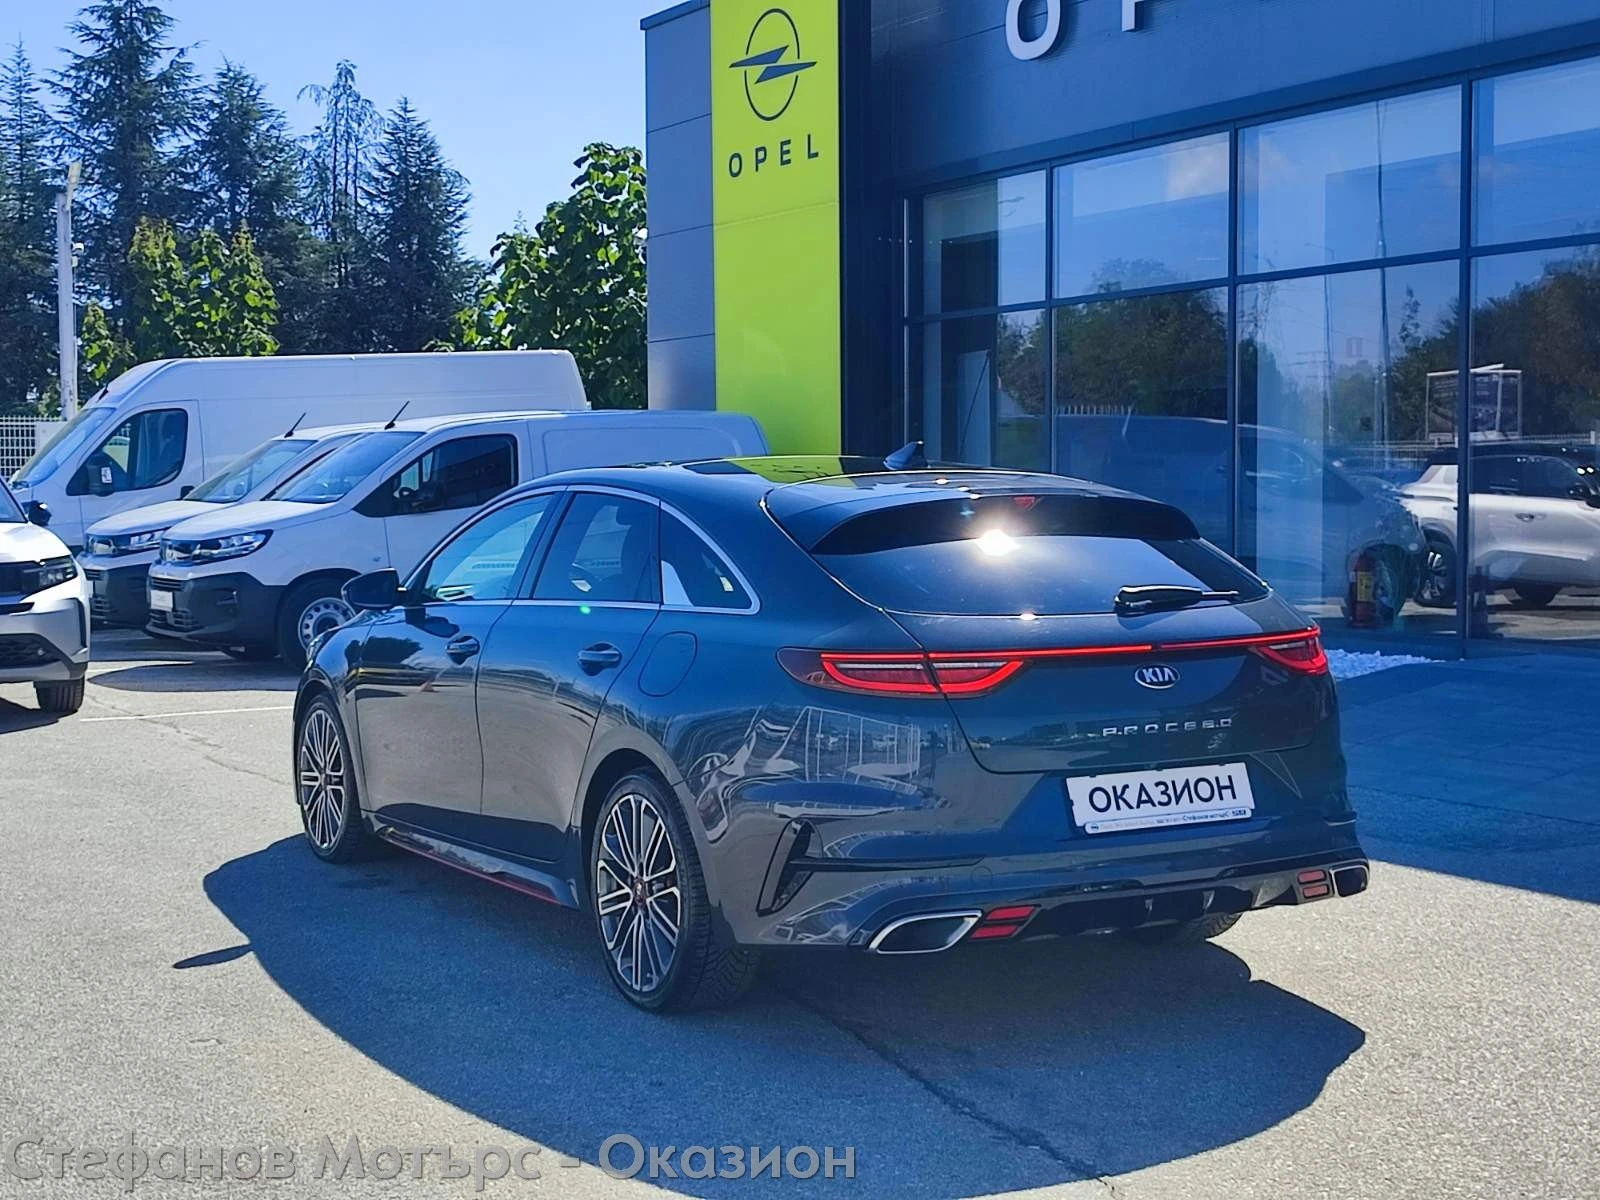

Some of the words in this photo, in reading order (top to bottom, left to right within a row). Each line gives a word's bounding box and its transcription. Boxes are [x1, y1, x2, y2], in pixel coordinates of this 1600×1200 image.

[728, 133, 819, 178] OPEL
[1142, 667, 1177, 683] KIA
[1088, 774, 1237, 813] ОКАЗИОН
